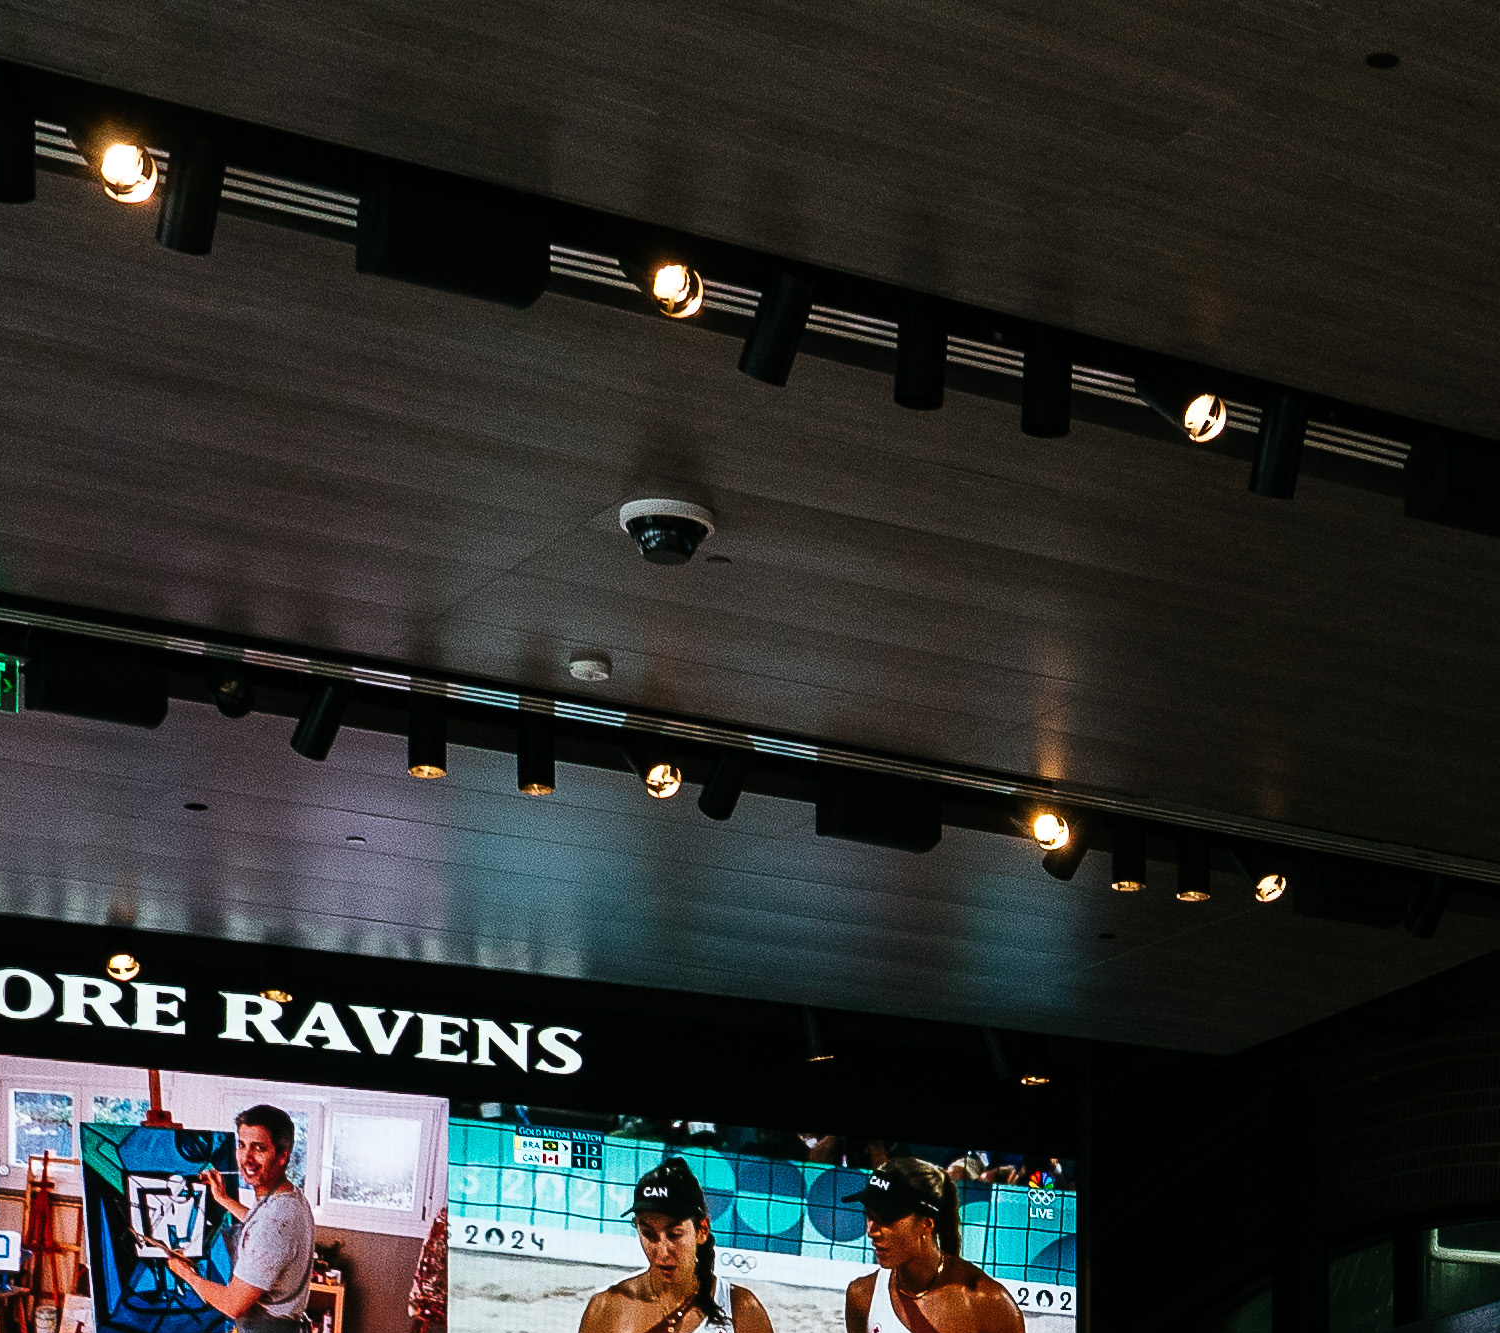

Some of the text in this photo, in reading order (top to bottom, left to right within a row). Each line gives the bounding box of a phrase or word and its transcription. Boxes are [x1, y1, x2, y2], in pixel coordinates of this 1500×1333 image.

[217, 990, 583, 1075] RAVENS
[518, 1126, 602, 1143] GOLD MEDAL MATCH
[522, 1140, 541, 1150] BRA
[591, 1146, 598, 1156] 2
[522, 1153, 541, 1163] CAN
[869, 1175, 891, 1191] CAN
[643, 1186, 669, 1198] CAN
[1029, 1207, 1054, 1220] LIVE
[465, 1224, 544, 1251] 2024
